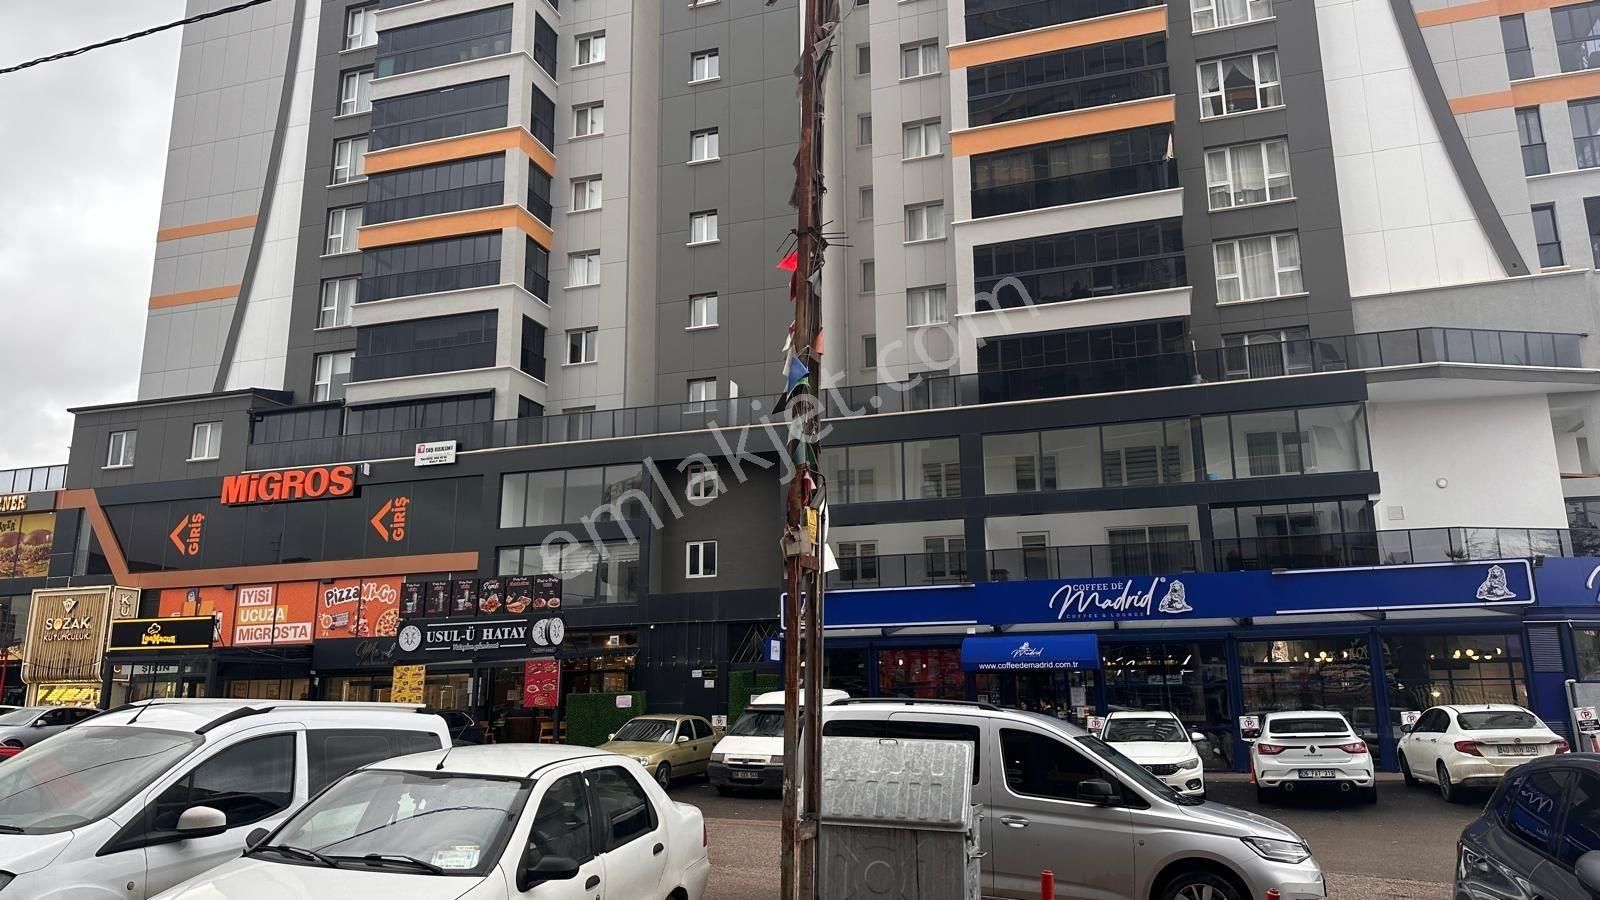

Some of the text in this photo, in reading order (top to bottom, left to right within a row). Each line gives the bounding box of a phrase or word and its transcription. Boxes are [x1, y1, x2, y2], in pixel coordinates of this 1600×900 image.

[0, 494, 26, 511] NER
[1072, 583, 1109, 592] COFFEE
[1049, 577, 1159, 620] Madrid
[240, 607, 285, 622] UCUZA
[45, 616, 90, 631] SOZAK
[426, 626, 527, 643] USUL-Ü HATAY
[979, 661, 1079, 670] www.coffeedemadrid.com.tr
